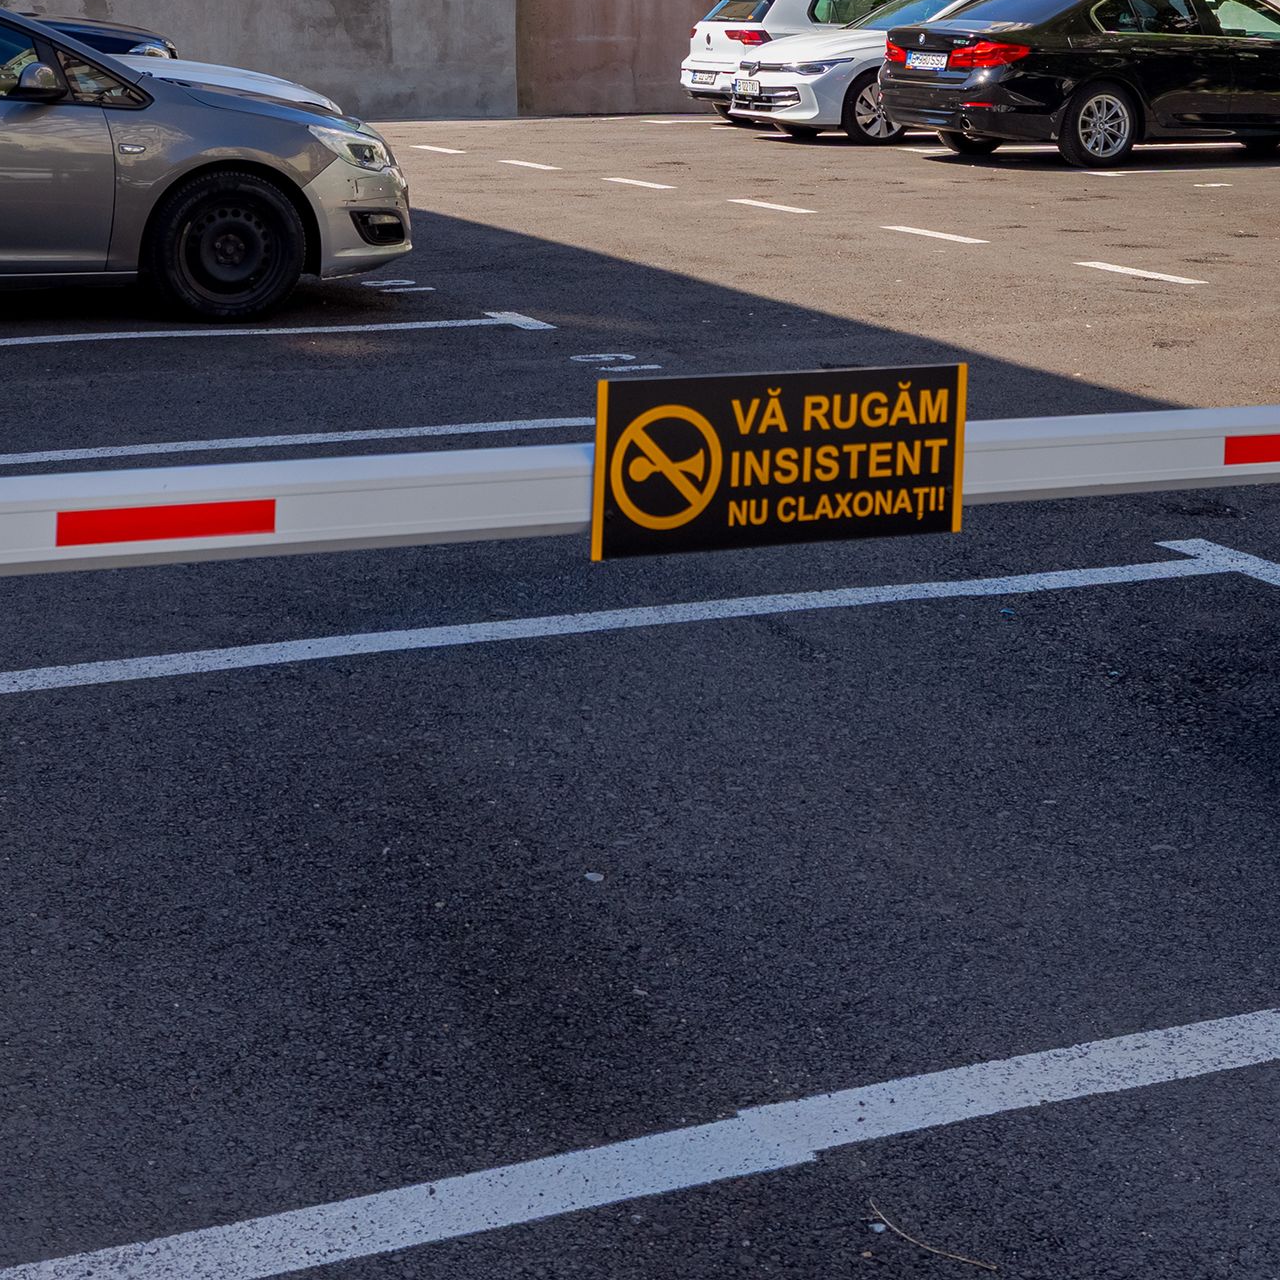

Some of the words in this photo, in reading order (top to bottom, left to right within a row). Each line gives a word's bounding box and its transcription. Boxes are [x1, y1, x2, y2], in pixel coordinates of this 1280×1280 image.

[731, 387, 788, 435] VĂ
[803, 381, 949, 432] RUGĂM
[730, 439, 948, 488] INSISTENT
[728, 498, 768, 527] NU
